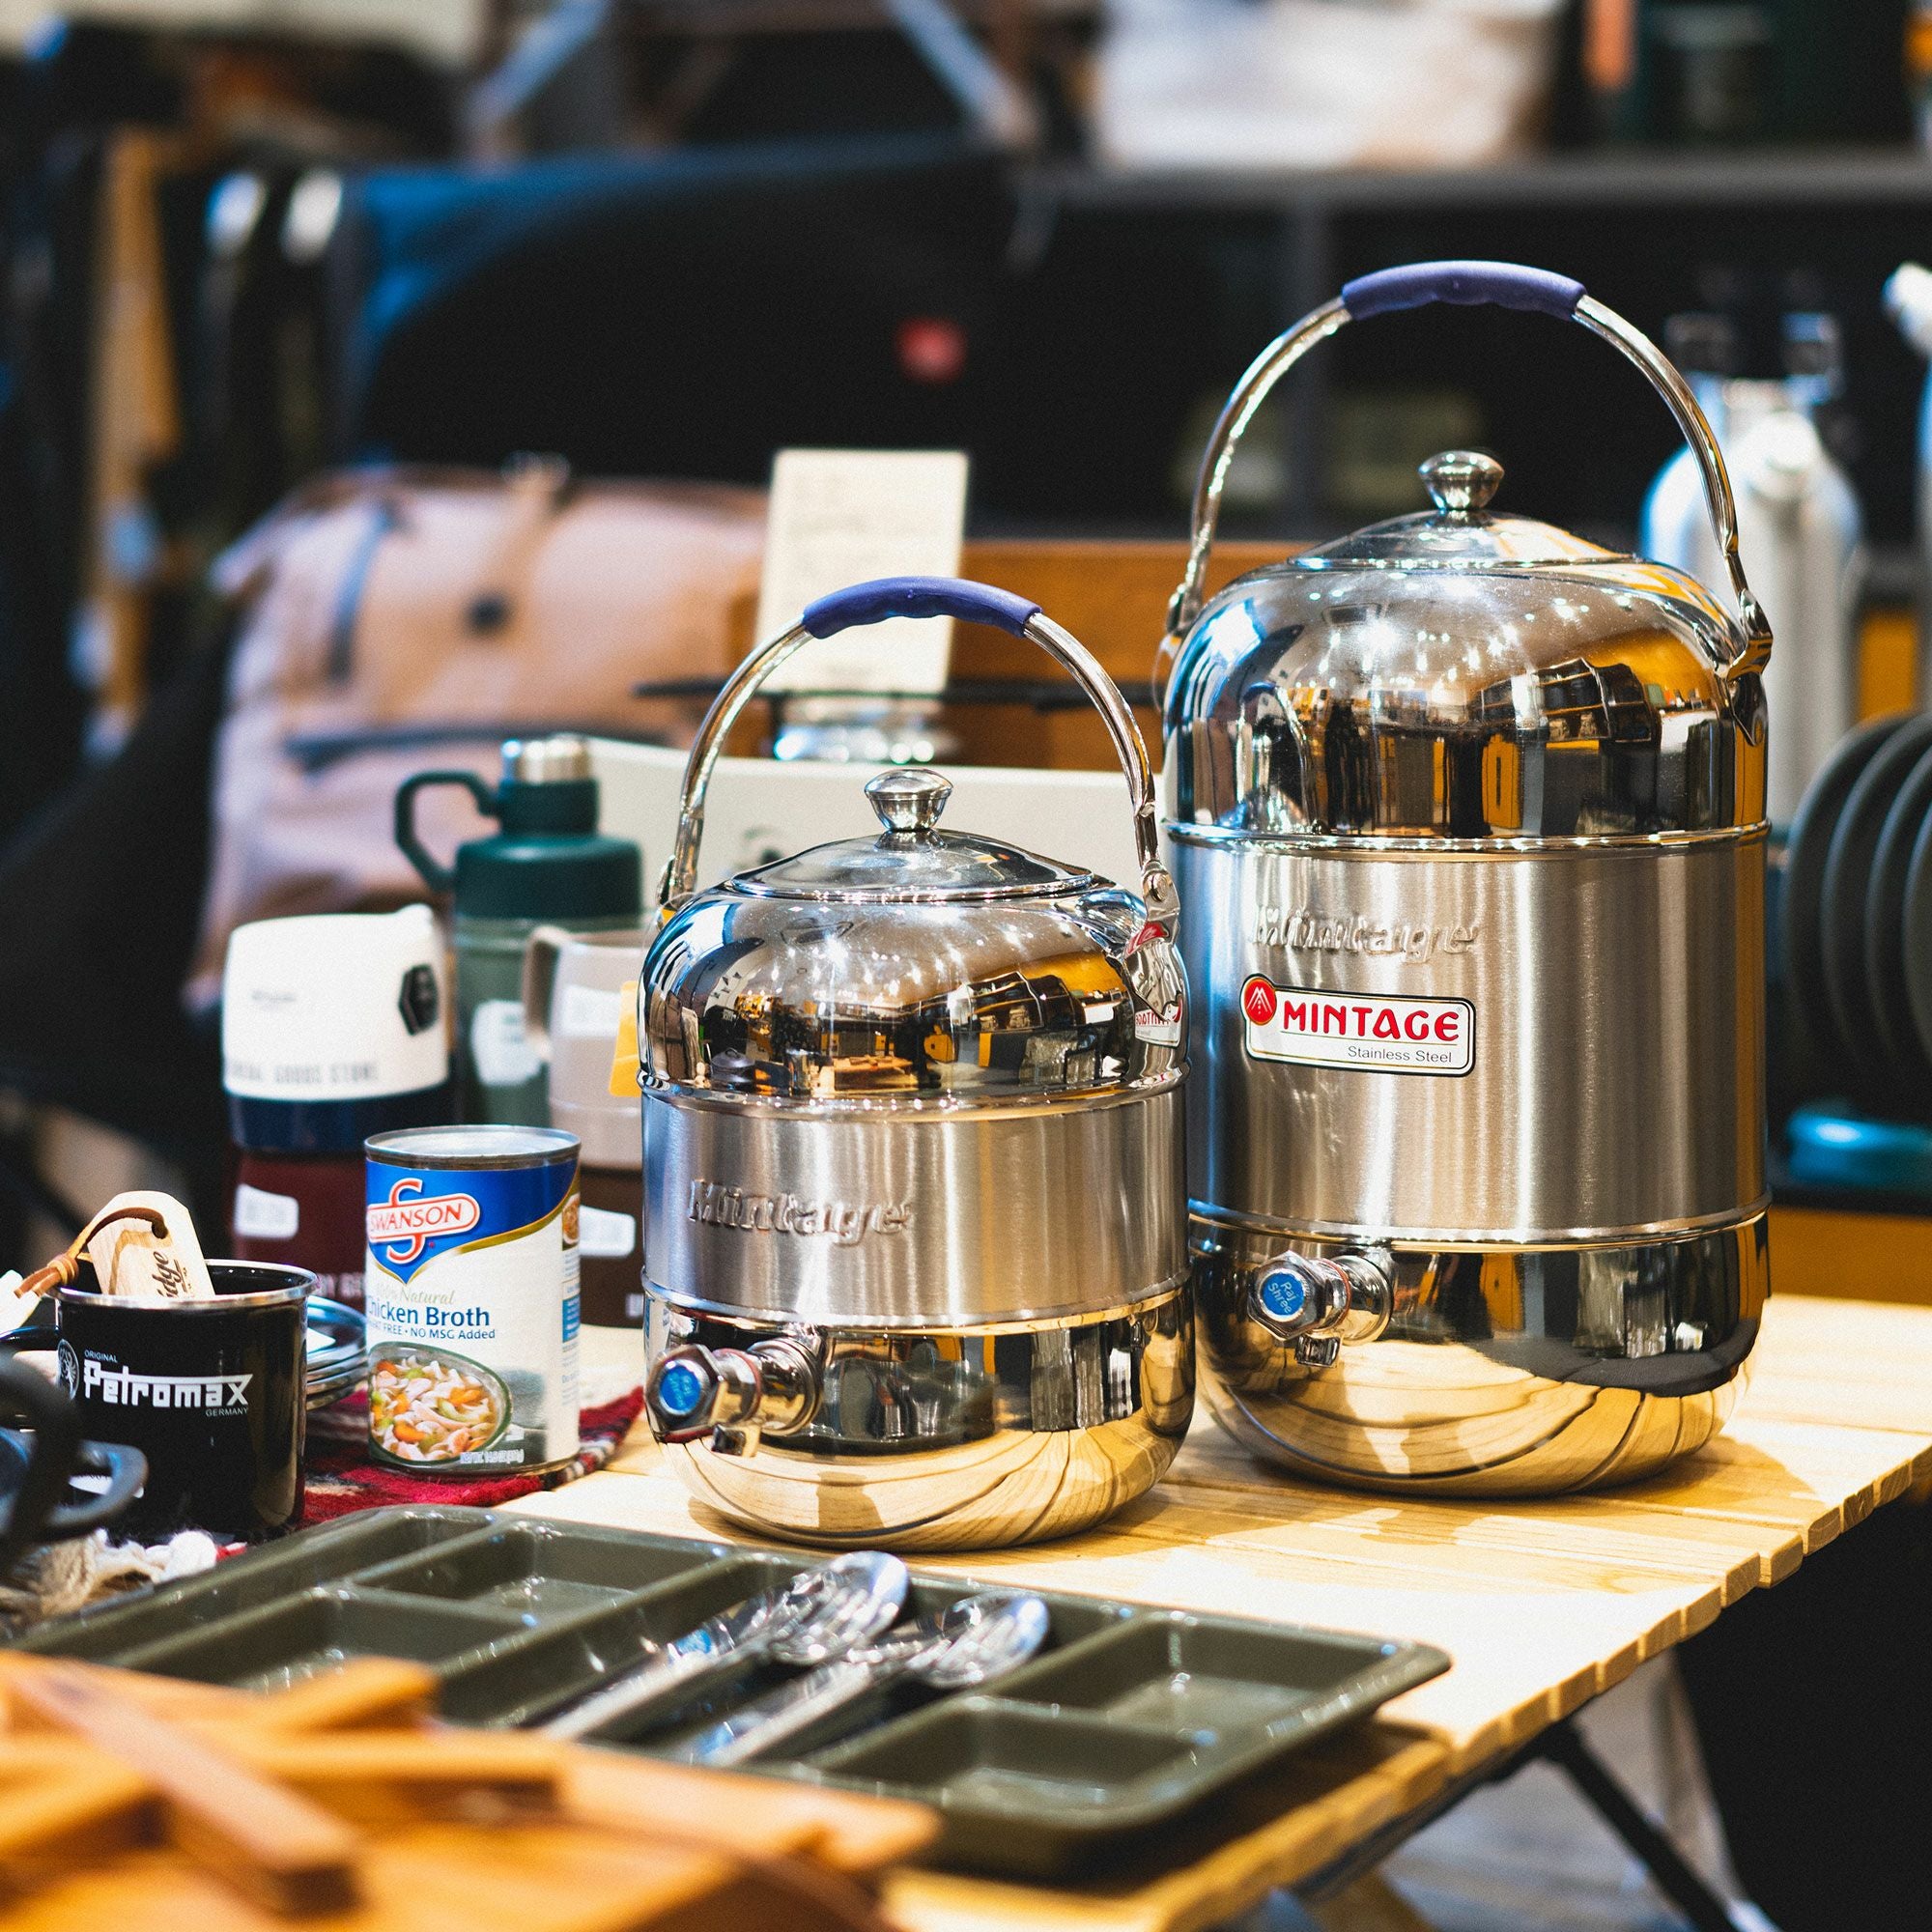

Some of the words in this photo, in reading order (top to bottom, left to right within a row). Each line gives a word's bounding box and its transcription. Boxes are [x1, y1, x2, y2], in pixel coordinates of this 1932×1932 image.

[1283, 1000, 1460, 1042] MINTAGE
[1348, 1045, 1410, 1062] Stainless
[1415, 1049, 1452, 1064] Steel
[370, 1203, 462, 1232] SWANSON
[688, 1179, 909, 1246] Mintage
[401, 1289, 455, 1305] Natural
[1267, 1282, 1293, 1314] Shree
[1280, 1281, 1297, 1302] Raj
[425, 1306, 491, 1327] Broth
[410, 1327, 426, 1338] NO
[429, 1328, 455, 1340] MSG
[457, 1328, 496, 1340] Added
[84, 1350, 118, 1364] ORIGINAL
[83, 1358, 254, 1408] Petromax
[205, 1406, 249, 1418] GERMANY
